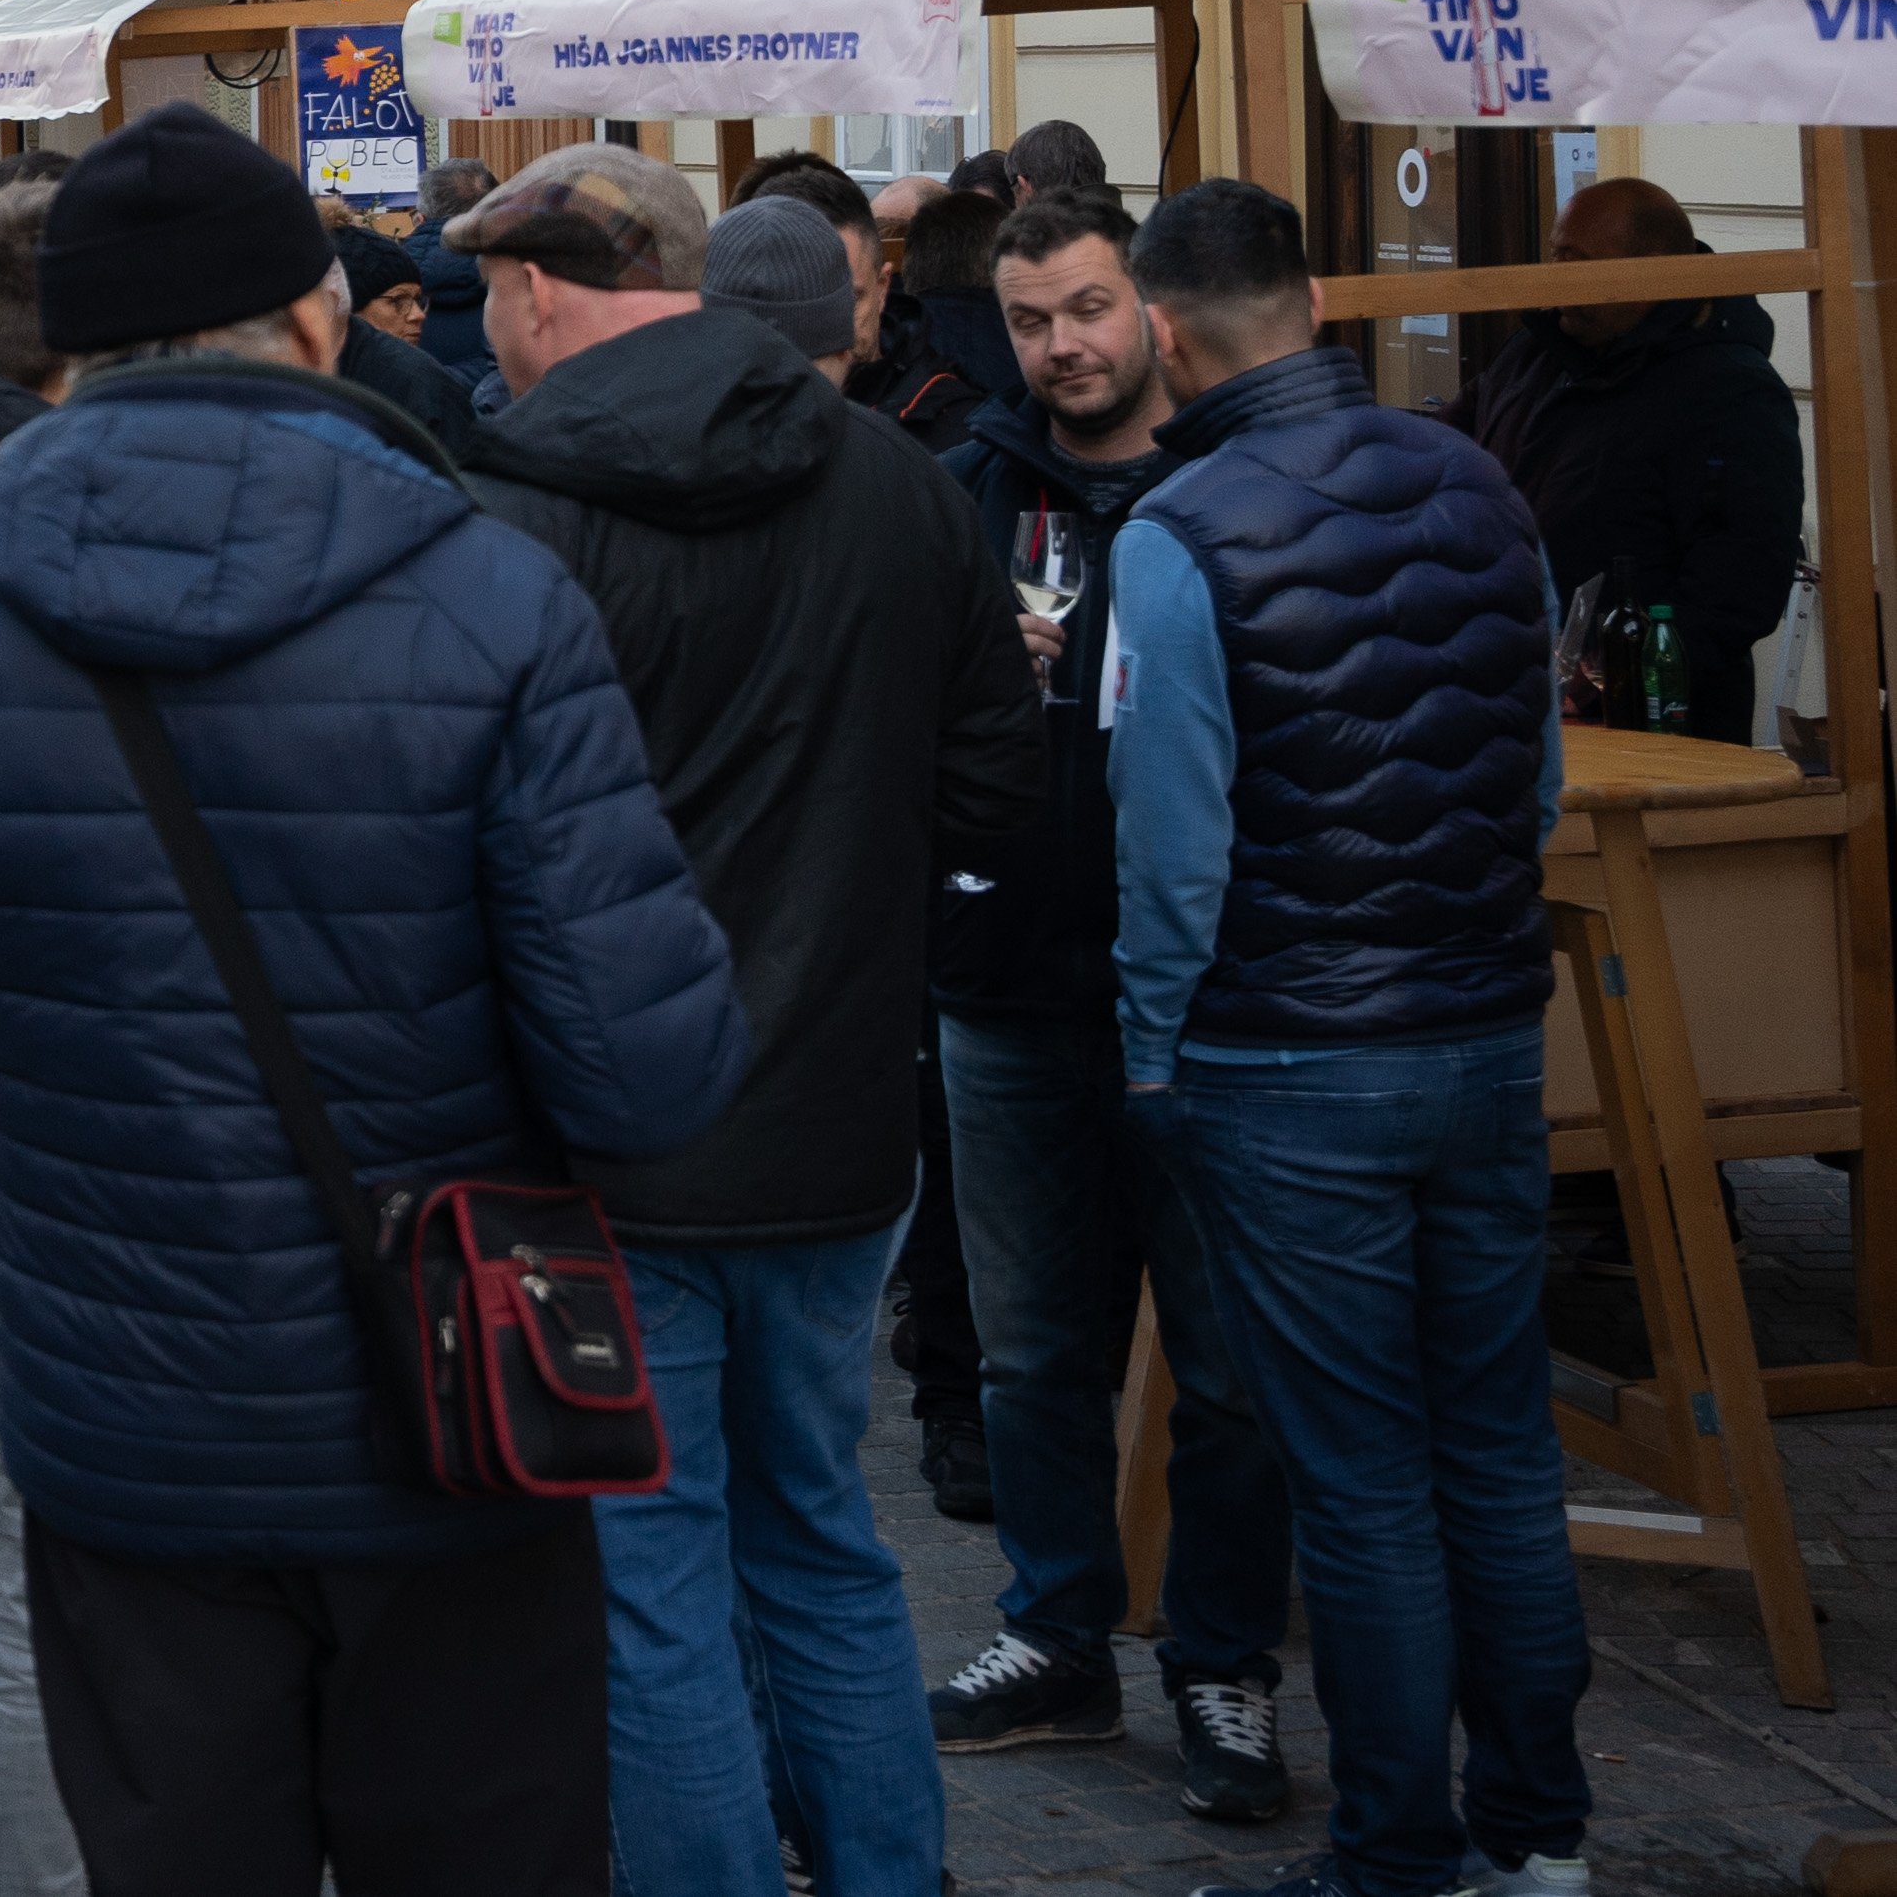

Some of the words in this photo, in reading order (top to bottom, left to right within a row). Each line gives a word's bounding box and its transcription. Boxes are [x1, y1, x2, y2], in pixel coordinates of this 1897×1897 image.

[473, 13, 516, 34] MAR
[553, 34, 610, 69] HIŠA
[616, 34, 732, 66] JOANNES
[736, 31, 859, 61] PROTNER
[493, 86, 516, 107] JE
[1506, 68, 1551, 103] JE
[304, 89, 414, 131] FALOT
